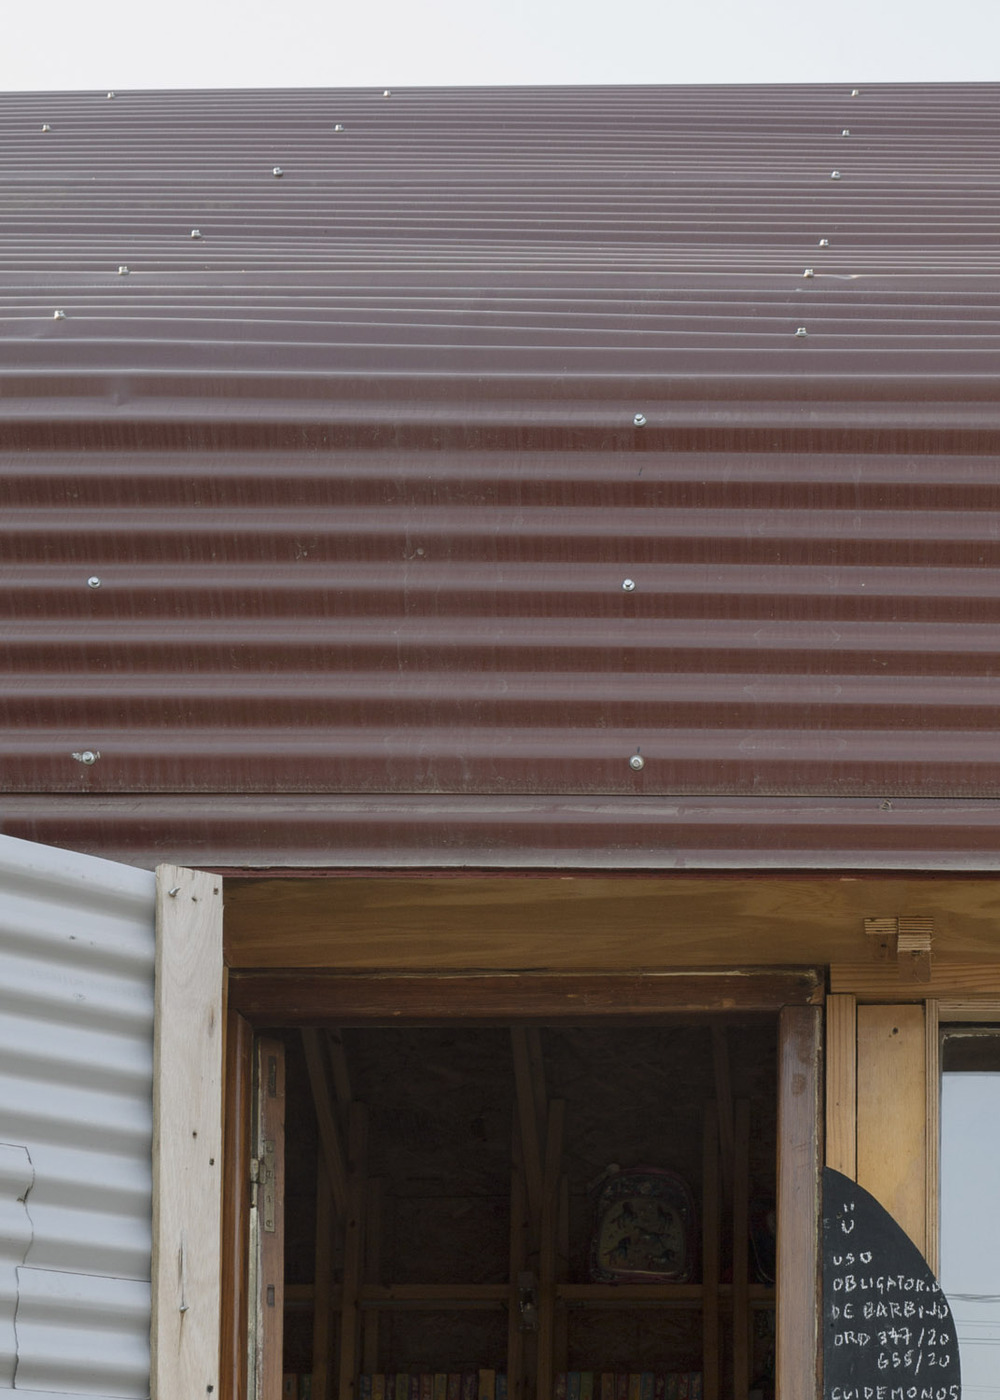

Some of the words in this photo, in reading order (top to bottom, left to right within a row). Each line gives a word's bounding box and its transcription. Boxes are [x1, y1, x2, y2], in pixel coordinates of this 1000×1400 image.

[833, 1251, 872, 1266] USO
[832, 1302, 854, 1319] DE
[863, 1301, 949, 1319] BARBIJO
[834, 1330, 871, 1346] ORD
